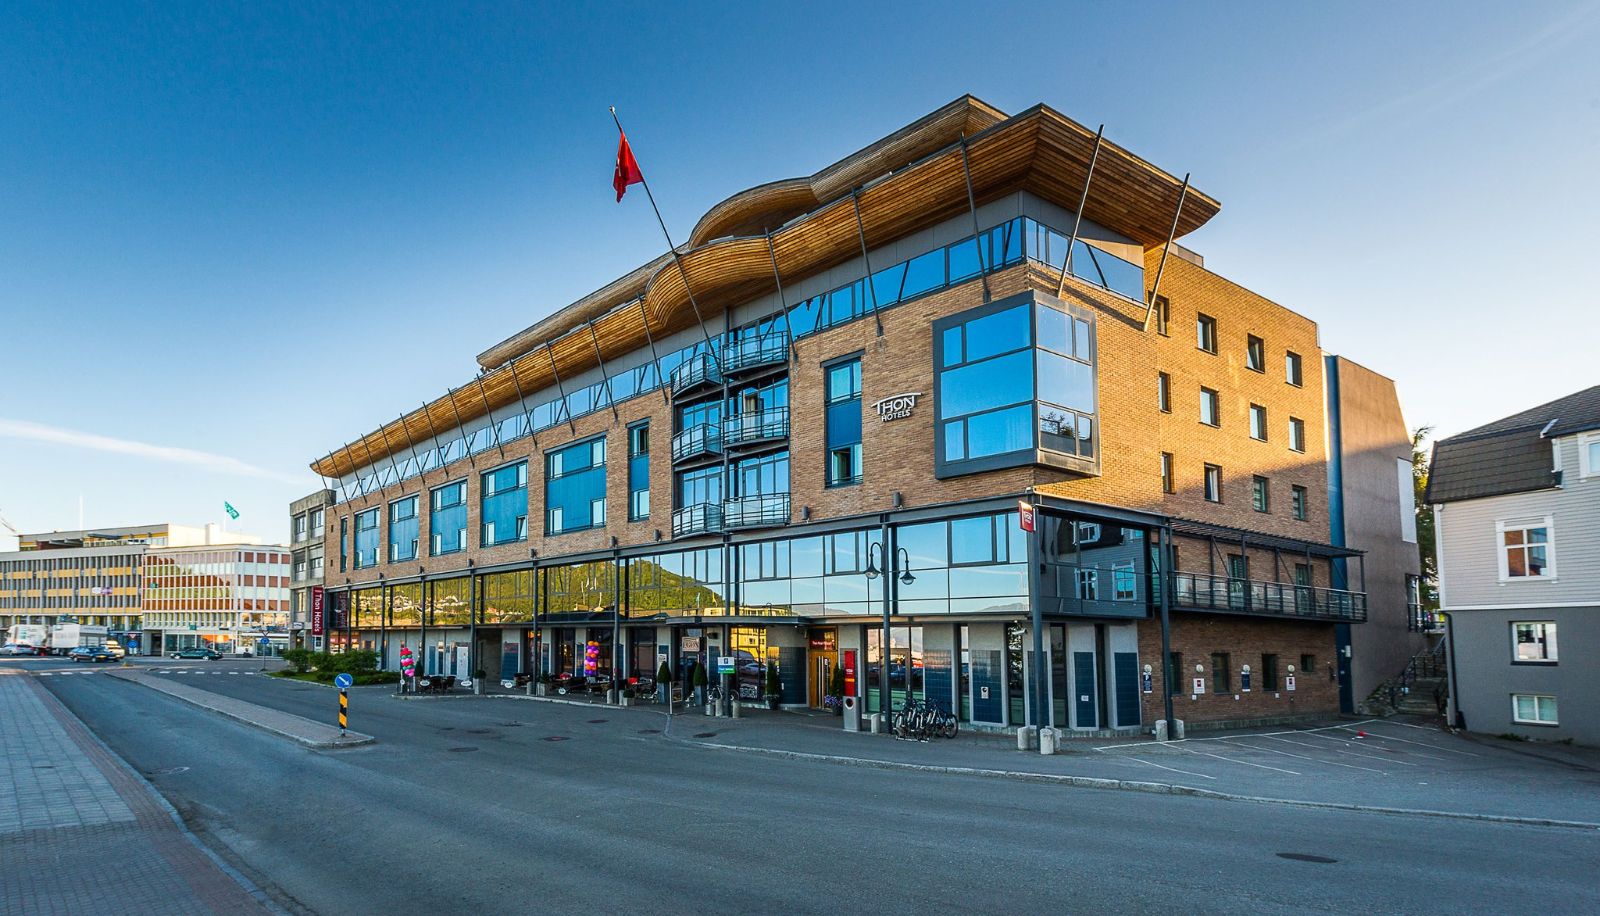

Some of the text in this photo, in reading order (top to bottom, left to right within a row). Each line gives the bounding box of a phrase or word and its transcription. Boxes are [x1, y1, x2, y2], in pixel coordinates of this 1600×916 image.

[870, 392, 922, 415] THON
[881, 409, 911, 422] HOTELS
[314, 594, 322, 610] Thon
[314, 611, 322, 632] Hotels
